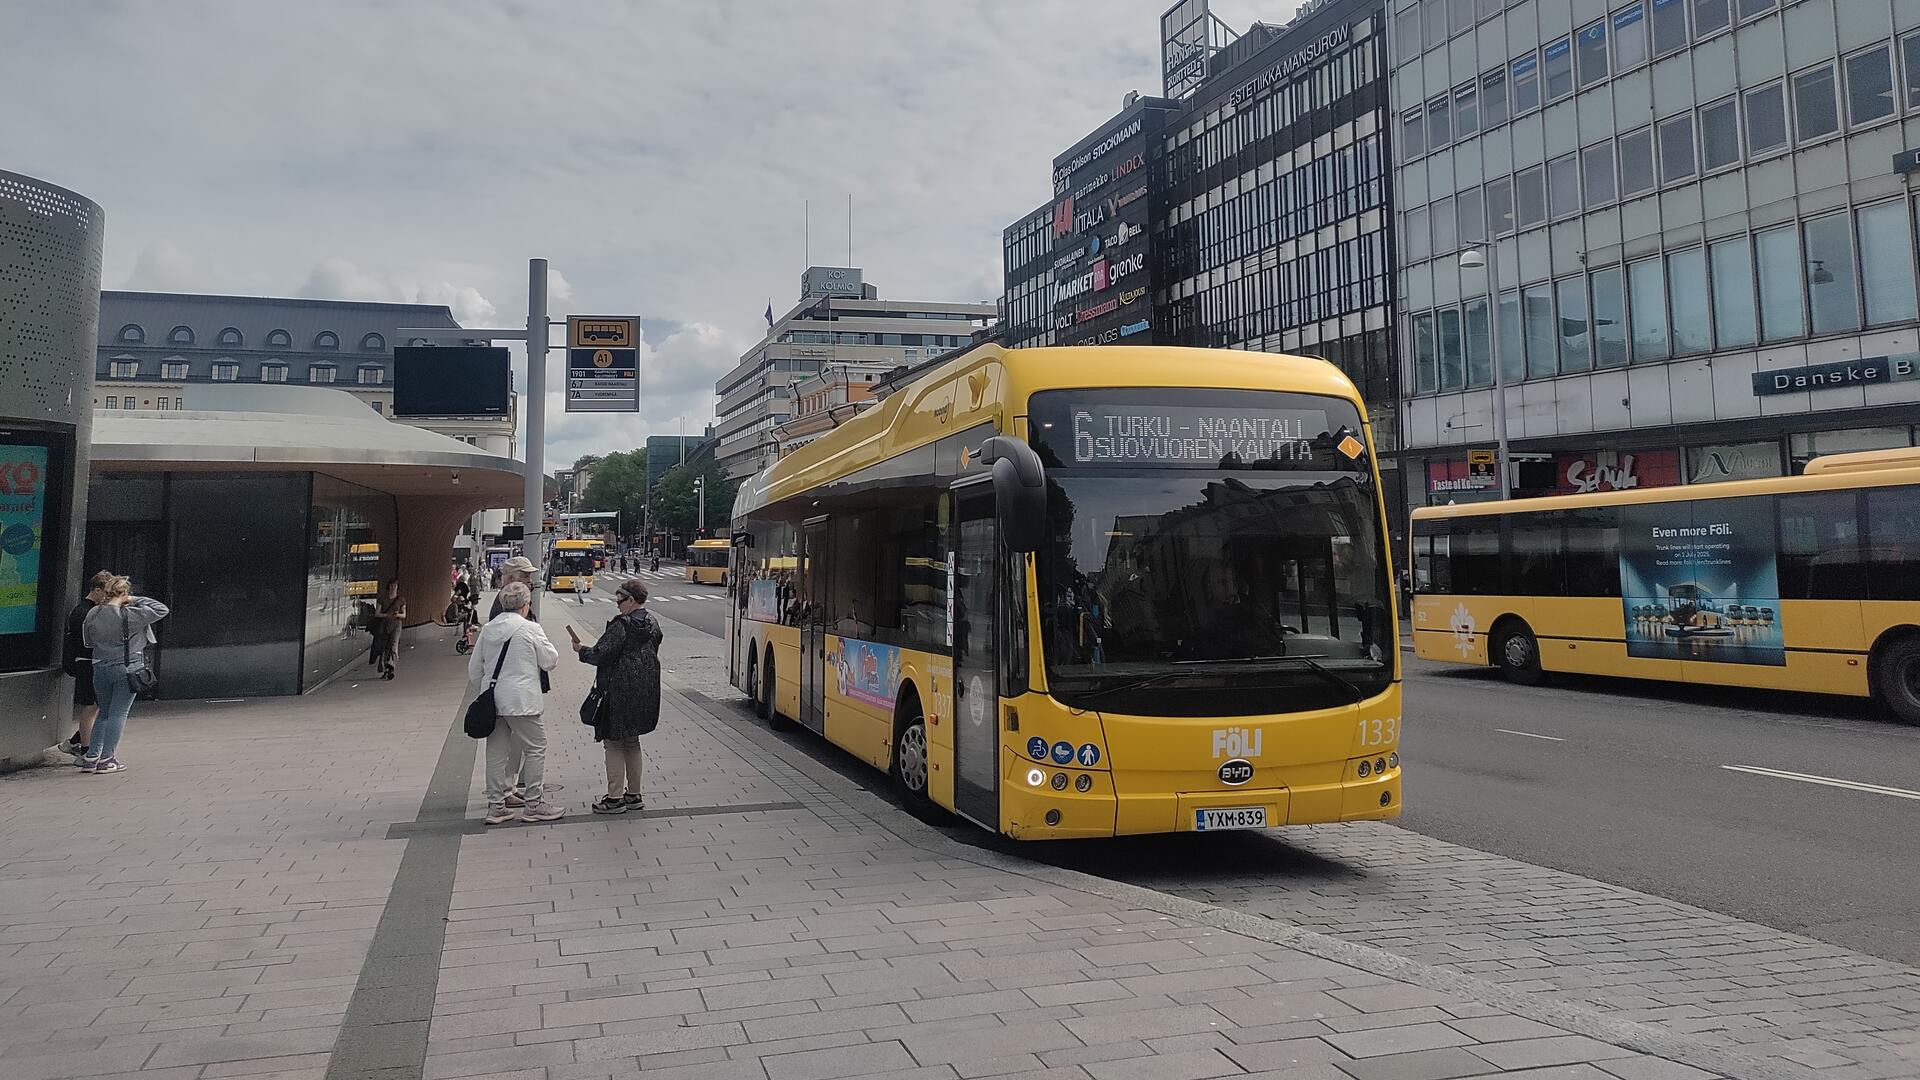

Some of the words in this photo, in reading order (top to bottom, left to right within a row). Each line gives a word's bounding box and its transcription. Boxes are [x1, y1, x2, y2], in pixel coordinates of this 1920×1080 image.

[1166, 41, 1196, 69] HANSA
[1230, 64, 1282, 107] ESTETIIKKA
[1283, 23, 1350, 74] MANSUROW
[1092, 119, 1141, 160] STOCKMANN
[1071, 151, 1091, 171] Ohlson
[1112, 152, 1145, 182] LINDEX
[1075, 173, 1109, 200] marimekko
[1128, 223, 1142, 238] BELL
[1105, 235, 1118, 249] TACO
[1054, 247, 1085, 269] SUOMALAINEN
[828, 270, 846, 279] KOP
[1109, 253, 1144, 285] grenke
[820, 282, 855, 291] KOLMIO
[1055, 313, 1073, 330] VOLT
[597, 354, 608, 363] A1
[572, 370, 586, 378] 1901
[1774, 366, 1878, 389] Danske
[1896, 360, 1920, 376] B
[1074, 411, 1093, 462] 6
[1104, 415, 1170, 438] TURKU
[1198, 418, 1303, 440] NAANTALI
[1096, 437, 1224, 460] SUOVUOREN
[1230, 438, 1313, 461] KAUTTA
[1433, 479, 1452, 491] Taste
[1452, 478, 1461, 490] of
[1652, 528, 1678, 538] Even
[1680, 528, 1707, 537] more
[1212, 727, 1262, 759] FÖLI
[1221, 766, 1252, 780] BYD
[1207, 811, 1263, 827] YXM-839
